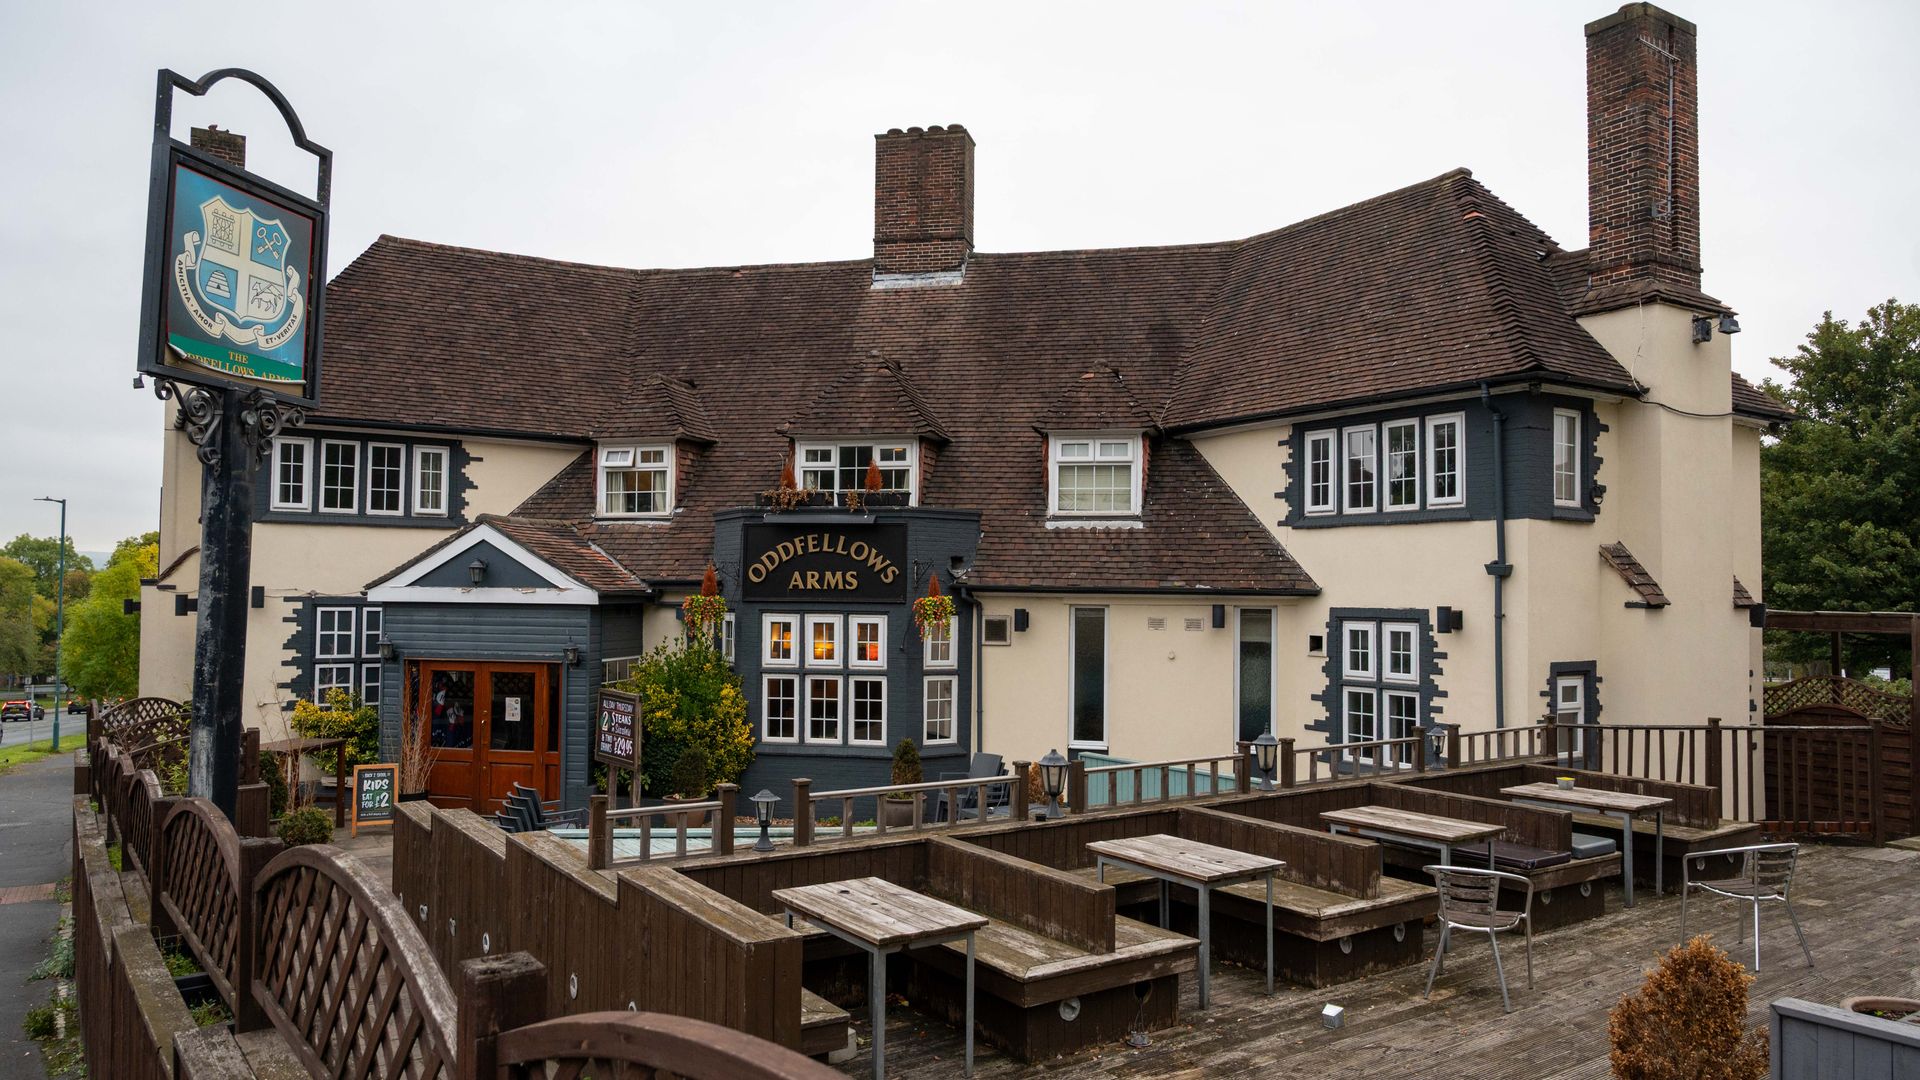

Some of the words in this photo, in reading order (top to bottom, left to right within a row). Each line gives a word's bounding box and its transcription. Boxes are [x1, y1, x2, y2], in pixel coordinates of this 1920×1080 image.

[177, 259, 192, 304] AMICITIA
[193, 308, 214, 330] AMOR
[265, 337, 274, 345] ET
[276, 314, 298, 341] VERITAS
[228, 351, 249, 364] THE
[748, 533, 900, 584] ODDFELLOWS
[788, 571, 859, 590] ARMS
[602, 711, 609, 731] 2
[612, 712, 632, 726] STEAKS
[363, 779, 389, 791] KIDS
[374, 792, 389, 808] £2
